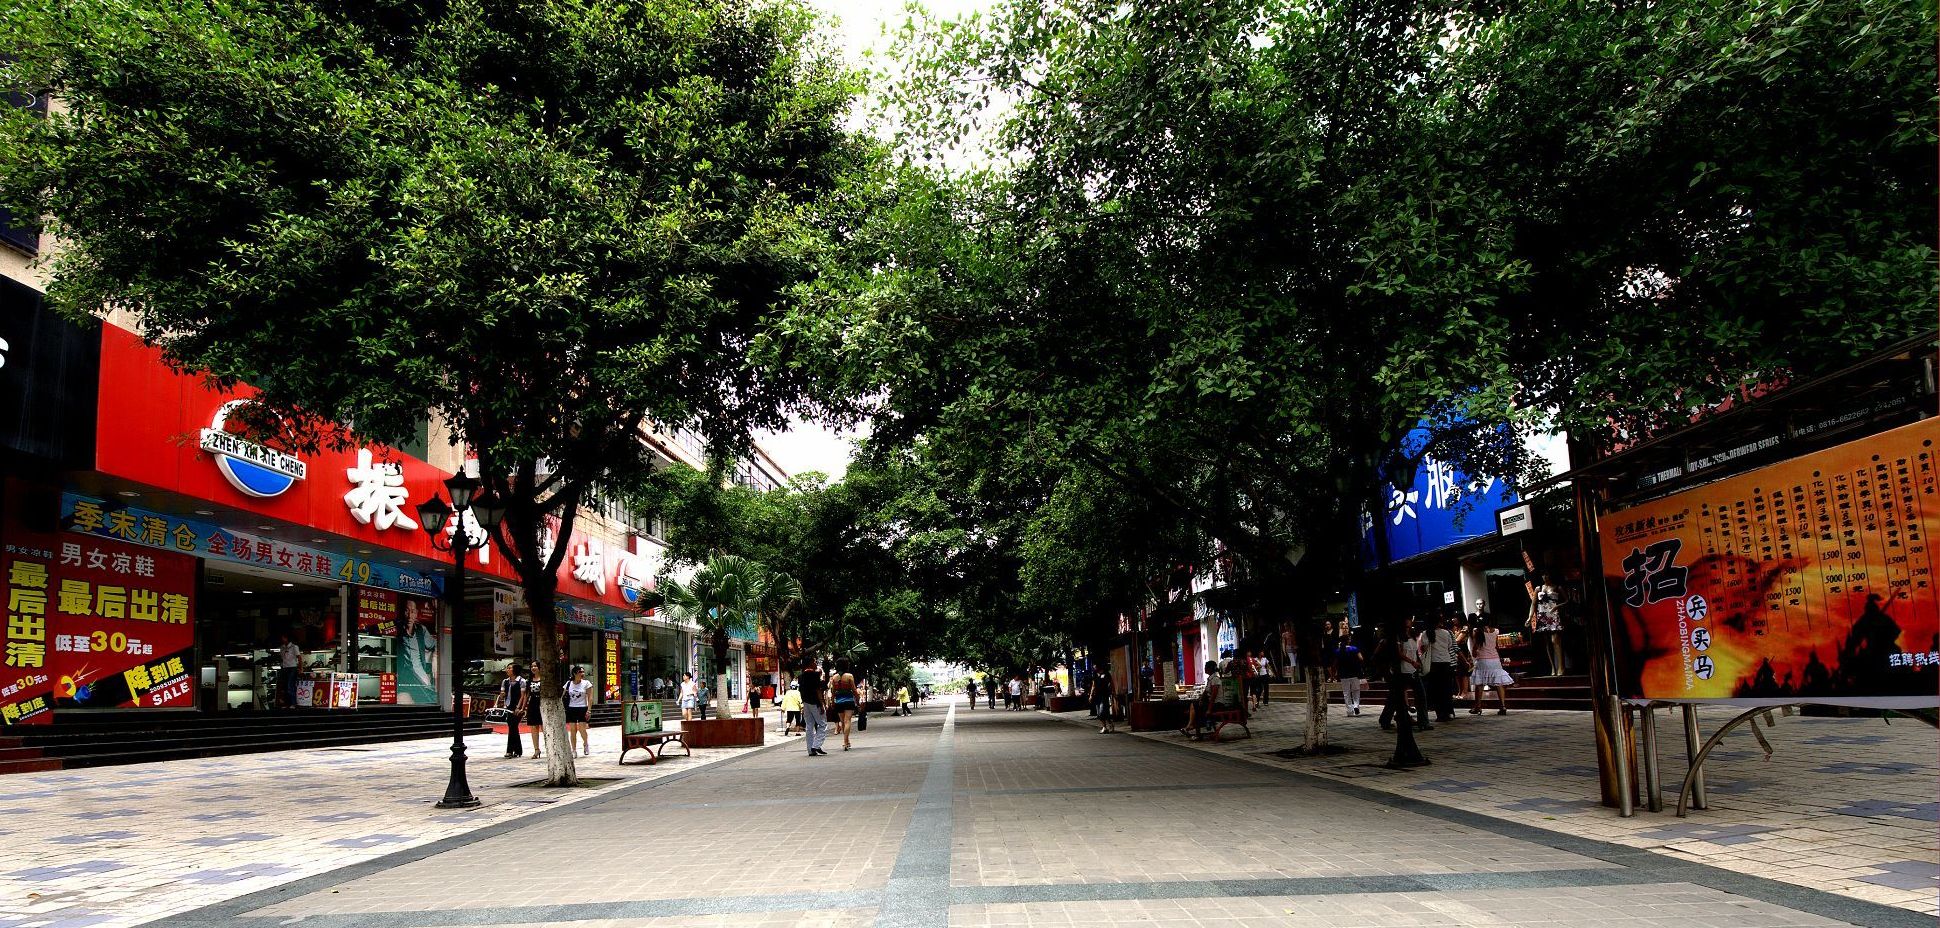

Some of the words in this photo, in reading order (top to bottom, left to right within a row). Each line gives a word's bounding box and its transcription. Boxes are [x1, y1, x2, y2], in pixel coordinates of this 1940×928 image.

[213, 433, 239, 454] ZHEN
[280, 456, 304, 477] CHENG
[60, 542, 155, 577] 男女凉鞋
[74, 500, 197, 552] 季末清仓
[207, 533, 332, 576] 全场男女凉鞋
[1622, 537, 1688, 608] 招
[6, 561, 48, 668] 最后出清
[58, 578, 189, 624] 最后出清
[56, 631, 153, 655] 低至30元起
[1676, 600, 1695, 690] ZHAOBINGMAIMA
[1688, 596, 1712, 679] 兵买马
[124, 656, 184, 702] 降到底
[605, 639, 618, 687] 最后出清
[152, 681, 190, 706] SALE
